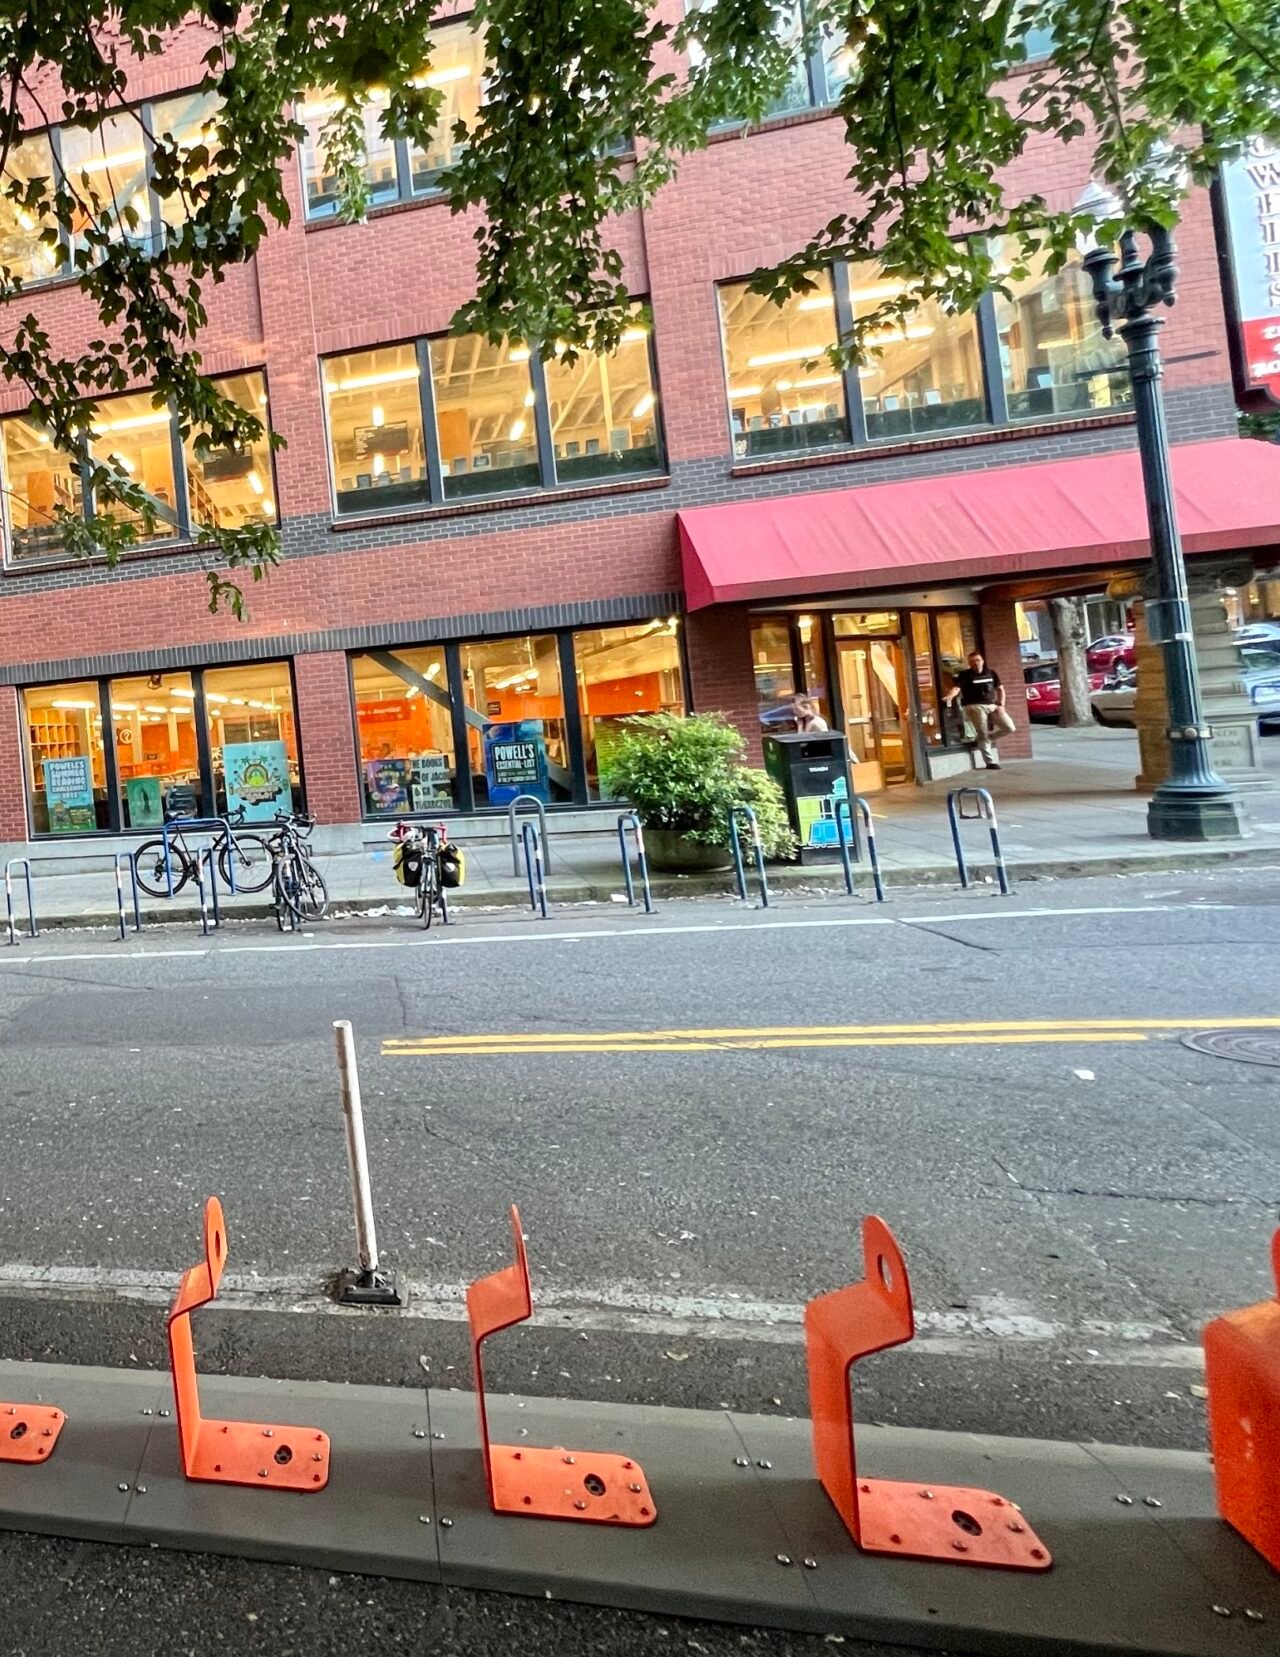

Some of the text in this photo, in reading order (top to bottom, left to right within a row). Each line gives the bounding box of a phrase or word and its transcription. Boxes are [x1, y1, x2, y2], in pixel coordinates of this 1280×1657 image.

[495, 744, 535, 760] POWELL'S
[421, 758, 443, 769] BOOKS
[524, 759, 535, 768] LIST
